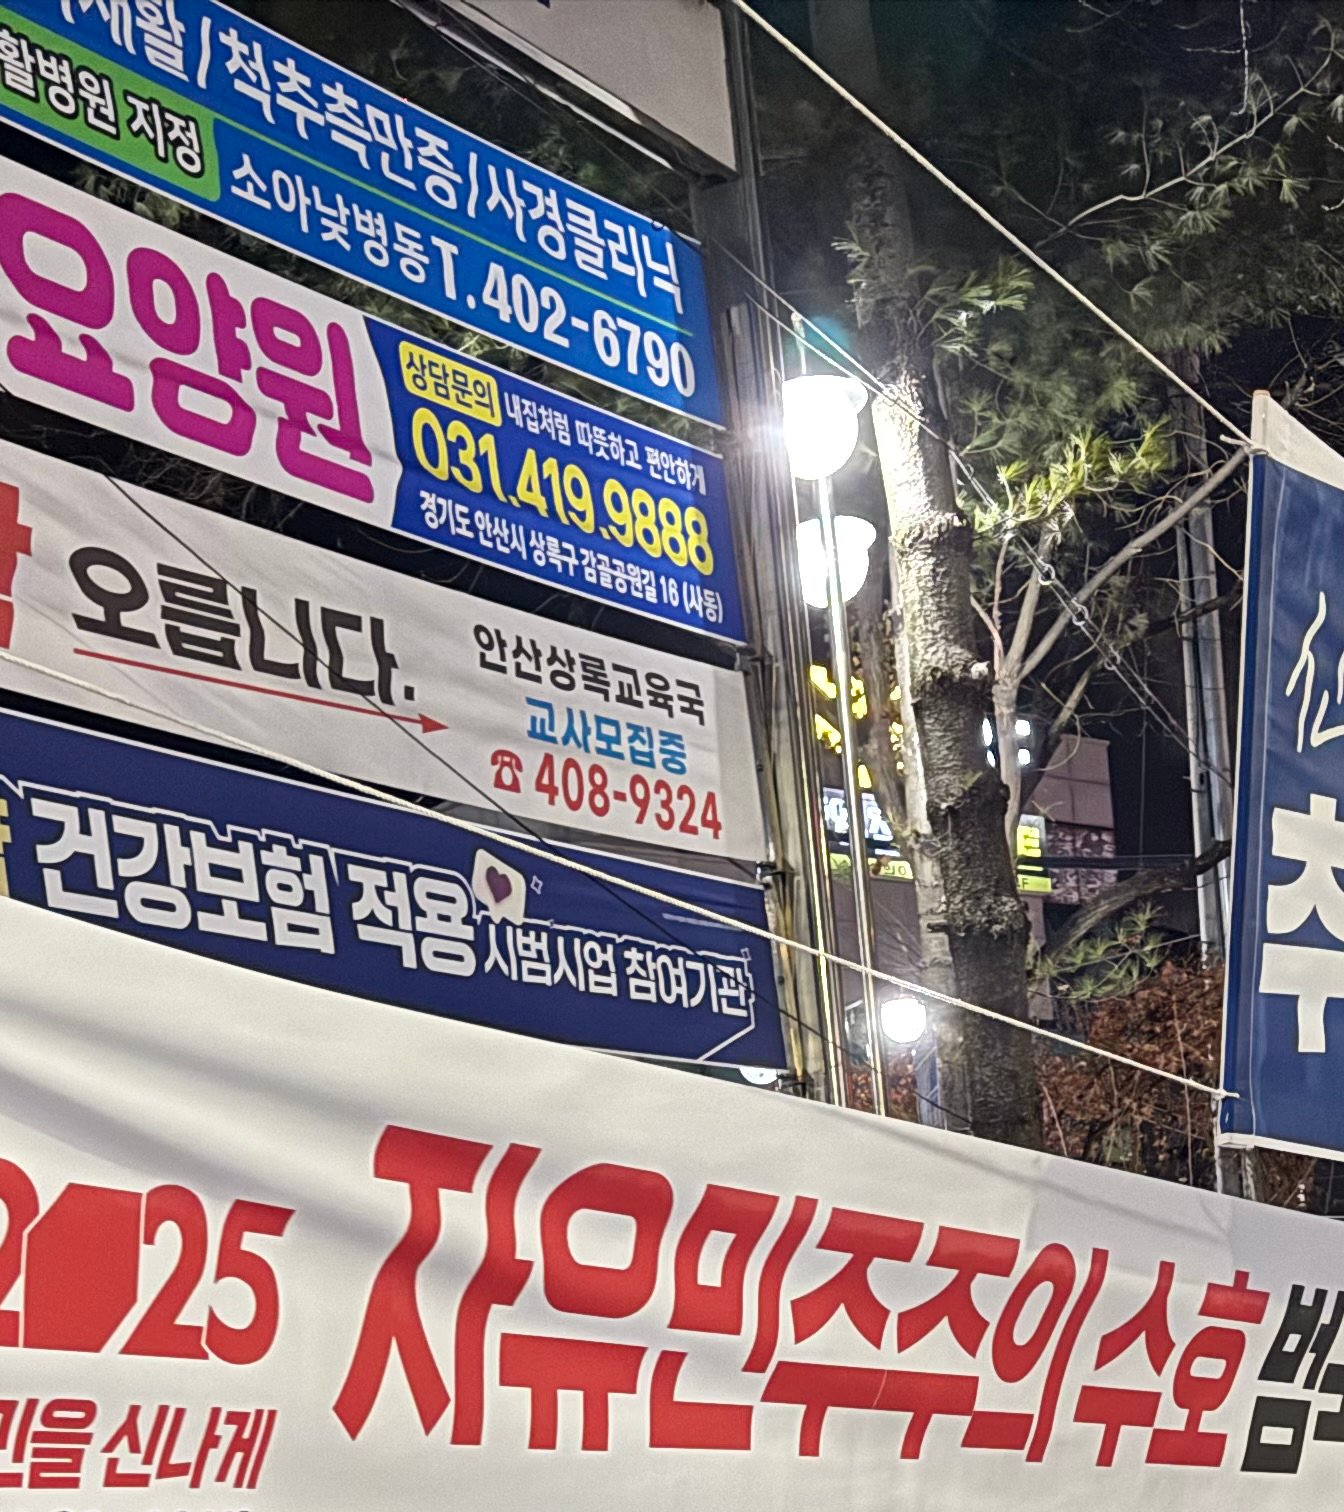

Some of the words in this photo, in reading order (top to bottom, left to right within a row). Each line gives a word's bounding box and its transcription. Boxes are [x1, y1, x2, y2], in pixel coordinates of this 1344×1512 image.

[124, 94, 202, 176] 지정
[405, 350, 495, 419] 상담문의
[503, 392, 571, 446] 내집처럼
[574, 419, 643, 471] 따뜻하고
[644, 444, 707, 496] 편안하게
[411, 407, 714, 577] 031.419.9888
[418, 490, 475, 540] 경기도
[474, 510, 528, 561] 안산시
[528, 529, 580, 577] 상록구
[658, 576, 679, 608] 16
[681, 581, 724, 625] (사동)
[67, 545, 416, 706] 오릅니다.
[472, 623, 706, 727] 안산상록교육국
[524, 696, 688, 776] 교사모집중
[534, 752, 723, 840] 408-9324
[29, 796, 336, 956] 건강보험
[346, 862, 478, 980] 적용
[623, 946, 749, 1018] 참여기관
[101, 1402, 278, 1490] 신나게
